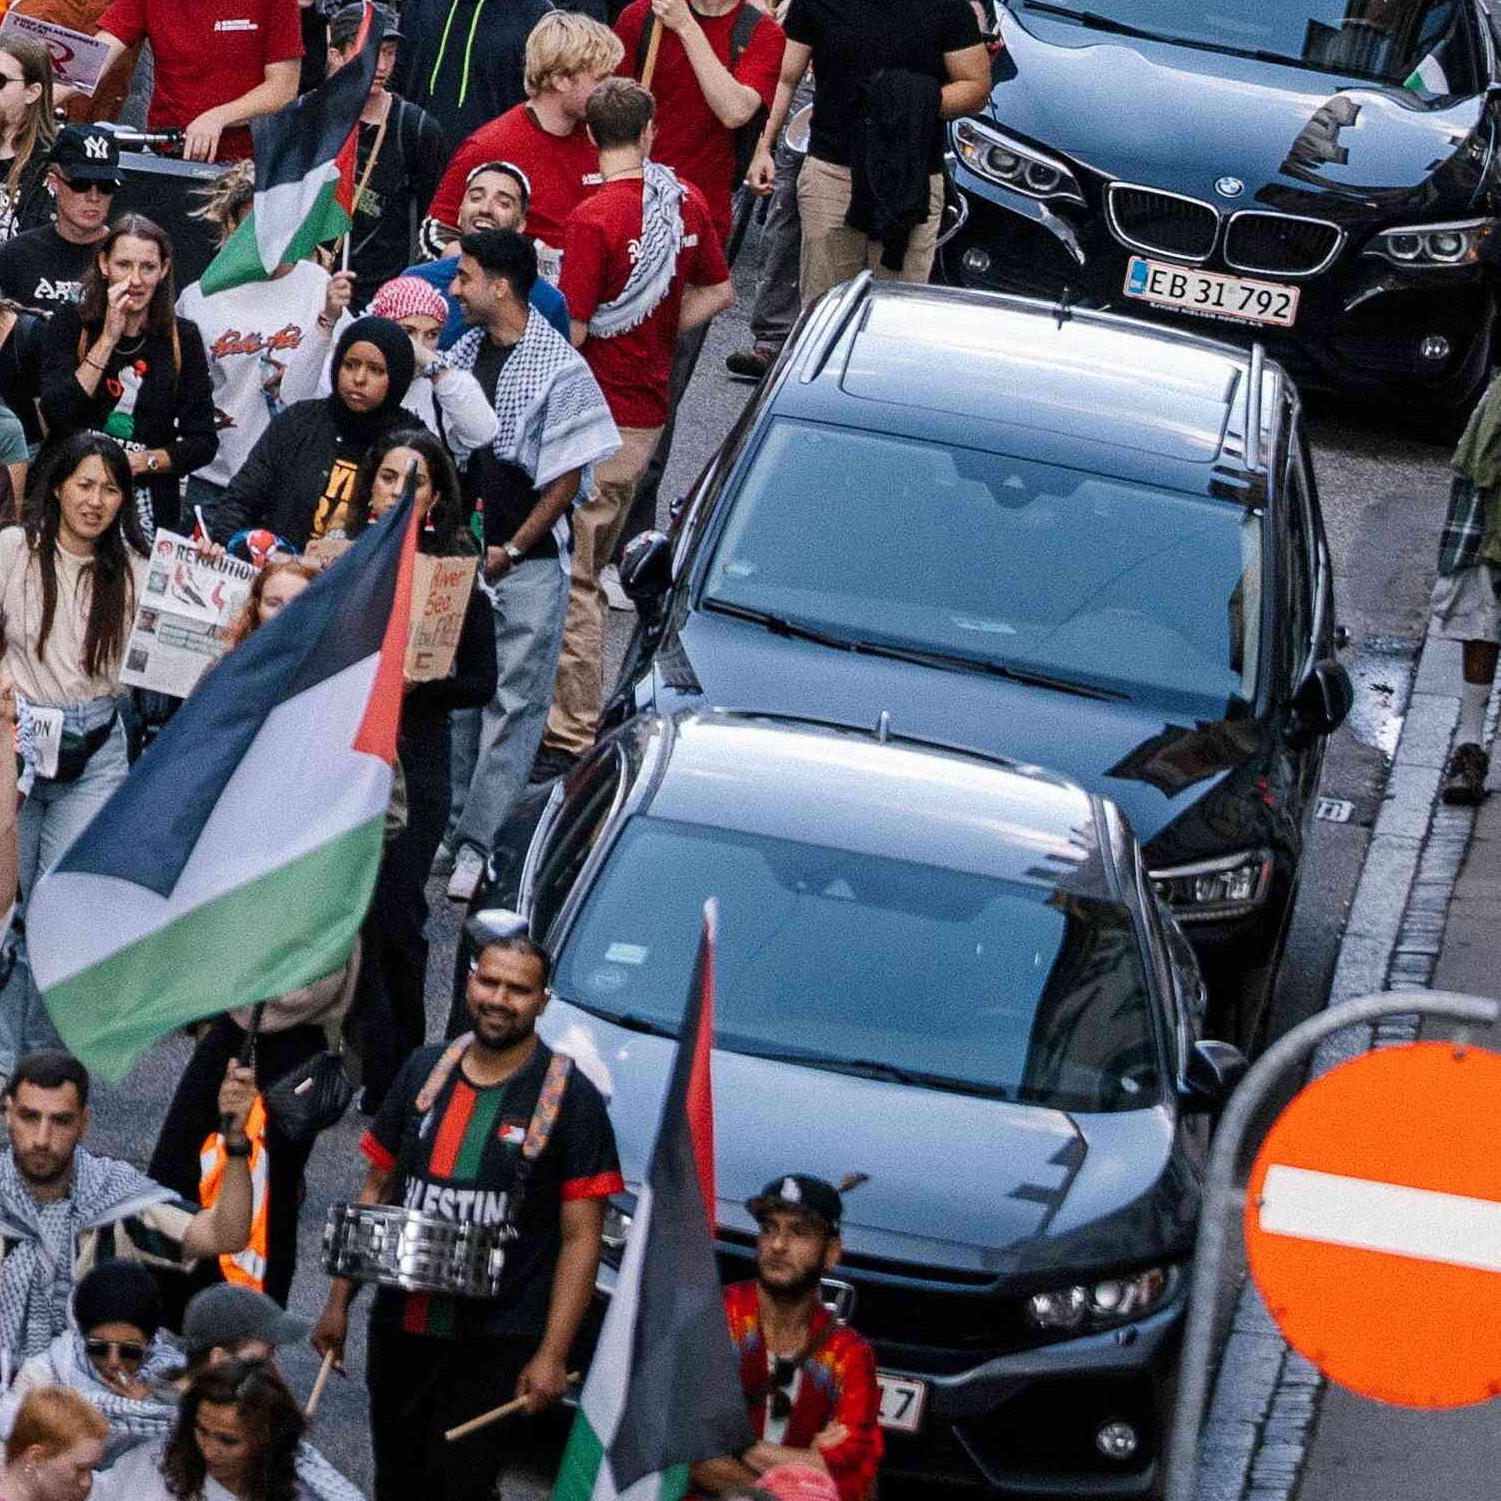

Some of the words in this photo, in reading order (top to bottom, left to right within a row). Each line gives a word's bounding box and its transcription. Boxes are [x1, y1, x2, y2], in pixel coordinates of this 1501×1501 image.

[83, 134, 109, 160] NY
[1148, 272, 1187, 299] EB
[1193, 282, 1228, 307] 31
[1238, 285, 1292, 319] 792
